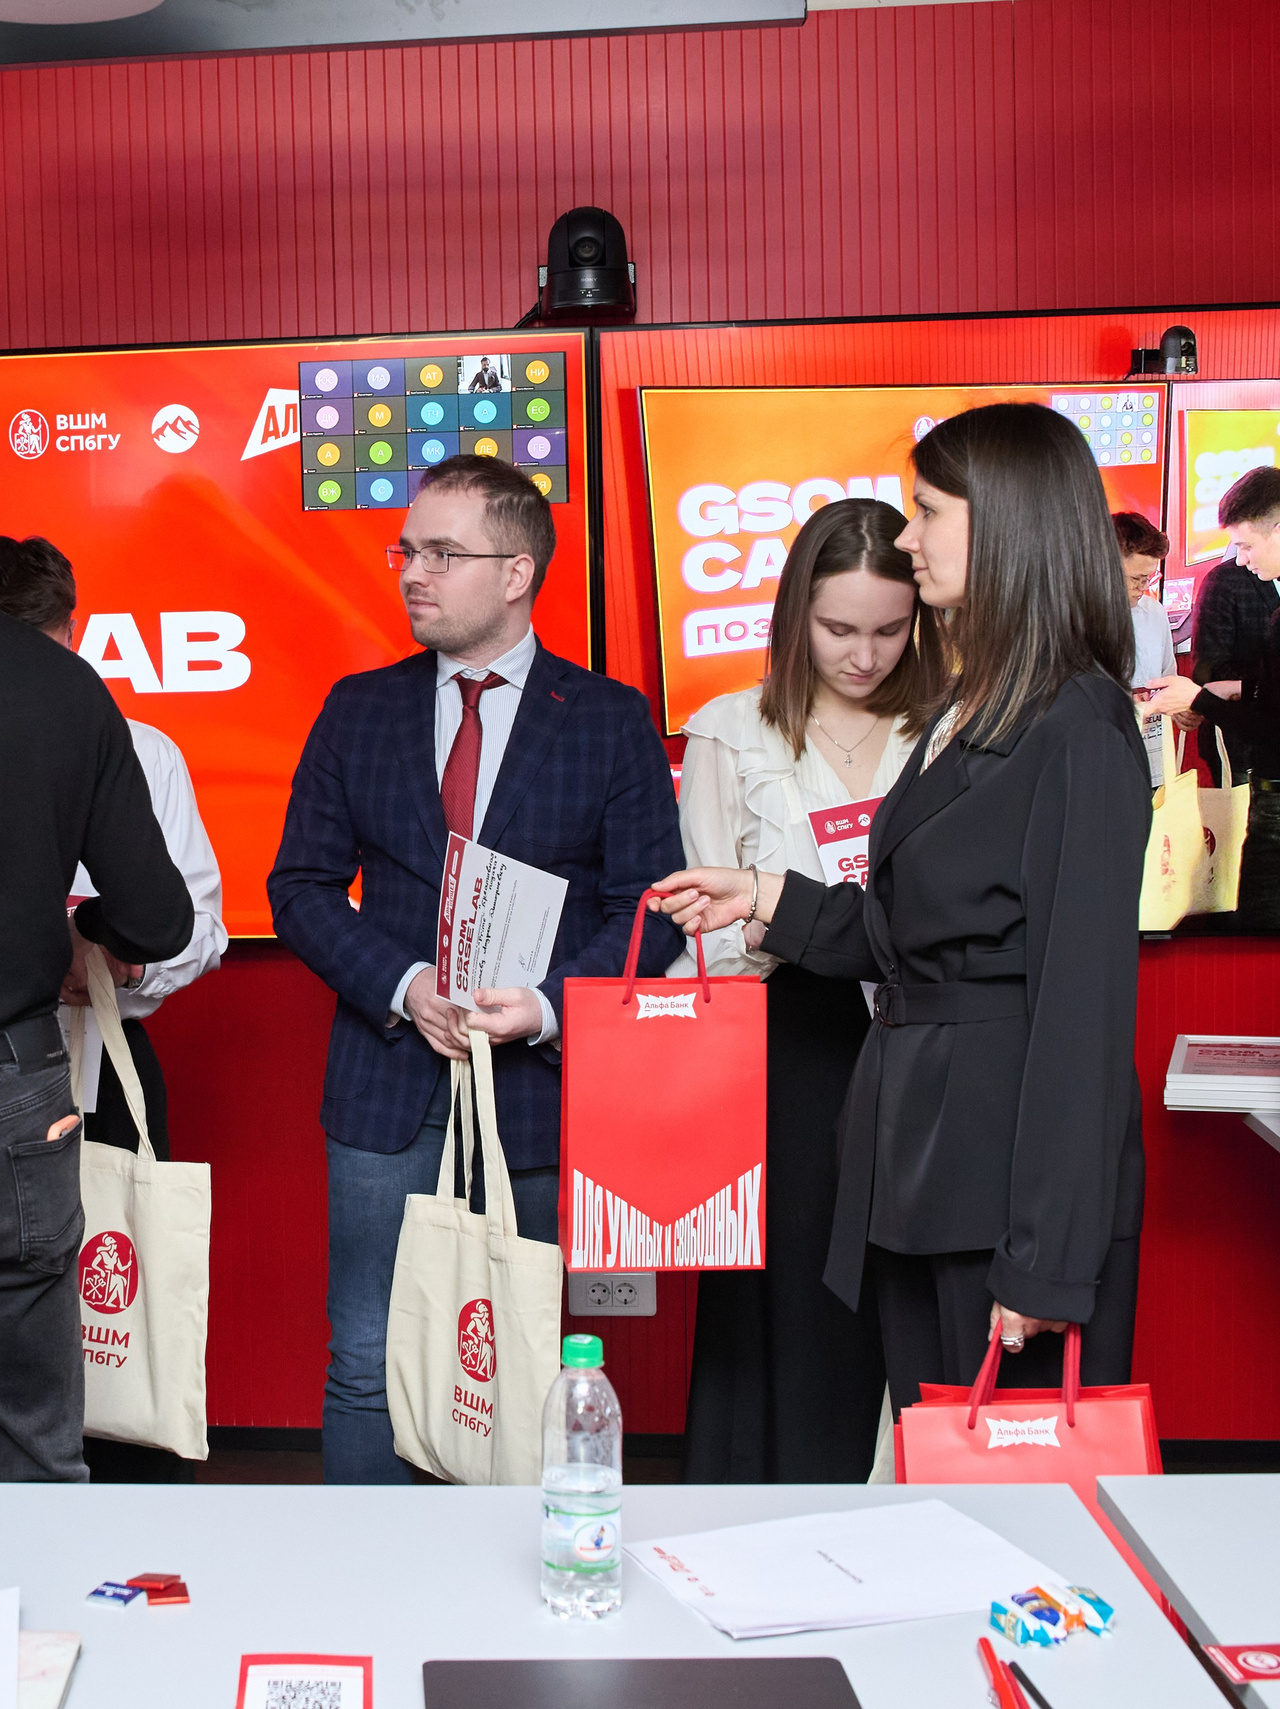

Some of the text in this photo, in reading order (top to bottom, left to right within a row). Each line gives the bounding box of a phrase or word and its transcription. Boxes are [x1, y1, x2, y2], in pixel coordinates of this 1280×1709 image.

[425, 372, 438, 380] АТ
[56, 413, 107, 430] ВШМ
[260, 403, 298, 445] АЛ
[55, 434, 121, 451] СПбГУ
[682, 538, 788, 593] CA
[697, 618, 772, 646] ПОЗ
[77, 611, 251, 693] AB
[838, 854, 869, 872] GS
[463, 926, 474, 992] CASE
[469, 877, 482, 925] LAB
[456, 919, 468, 989] GSOM
[645, 1002, 669, 1011] Альфа
[572, 1169, 603, 1268] ДЛЯ
[606, 1189, 663, 1268] УМНЫХ
[674, 1163, 762, 1267] СВОБОДНЫХ
[83, 1348, 128, 1368] ПбГУ
[454, 1384, 493, 1419] ВШМ
[452, 1408, 491, 1437] СПбГУ
[997, 1427, 1050, 1439] Альфа Банк
